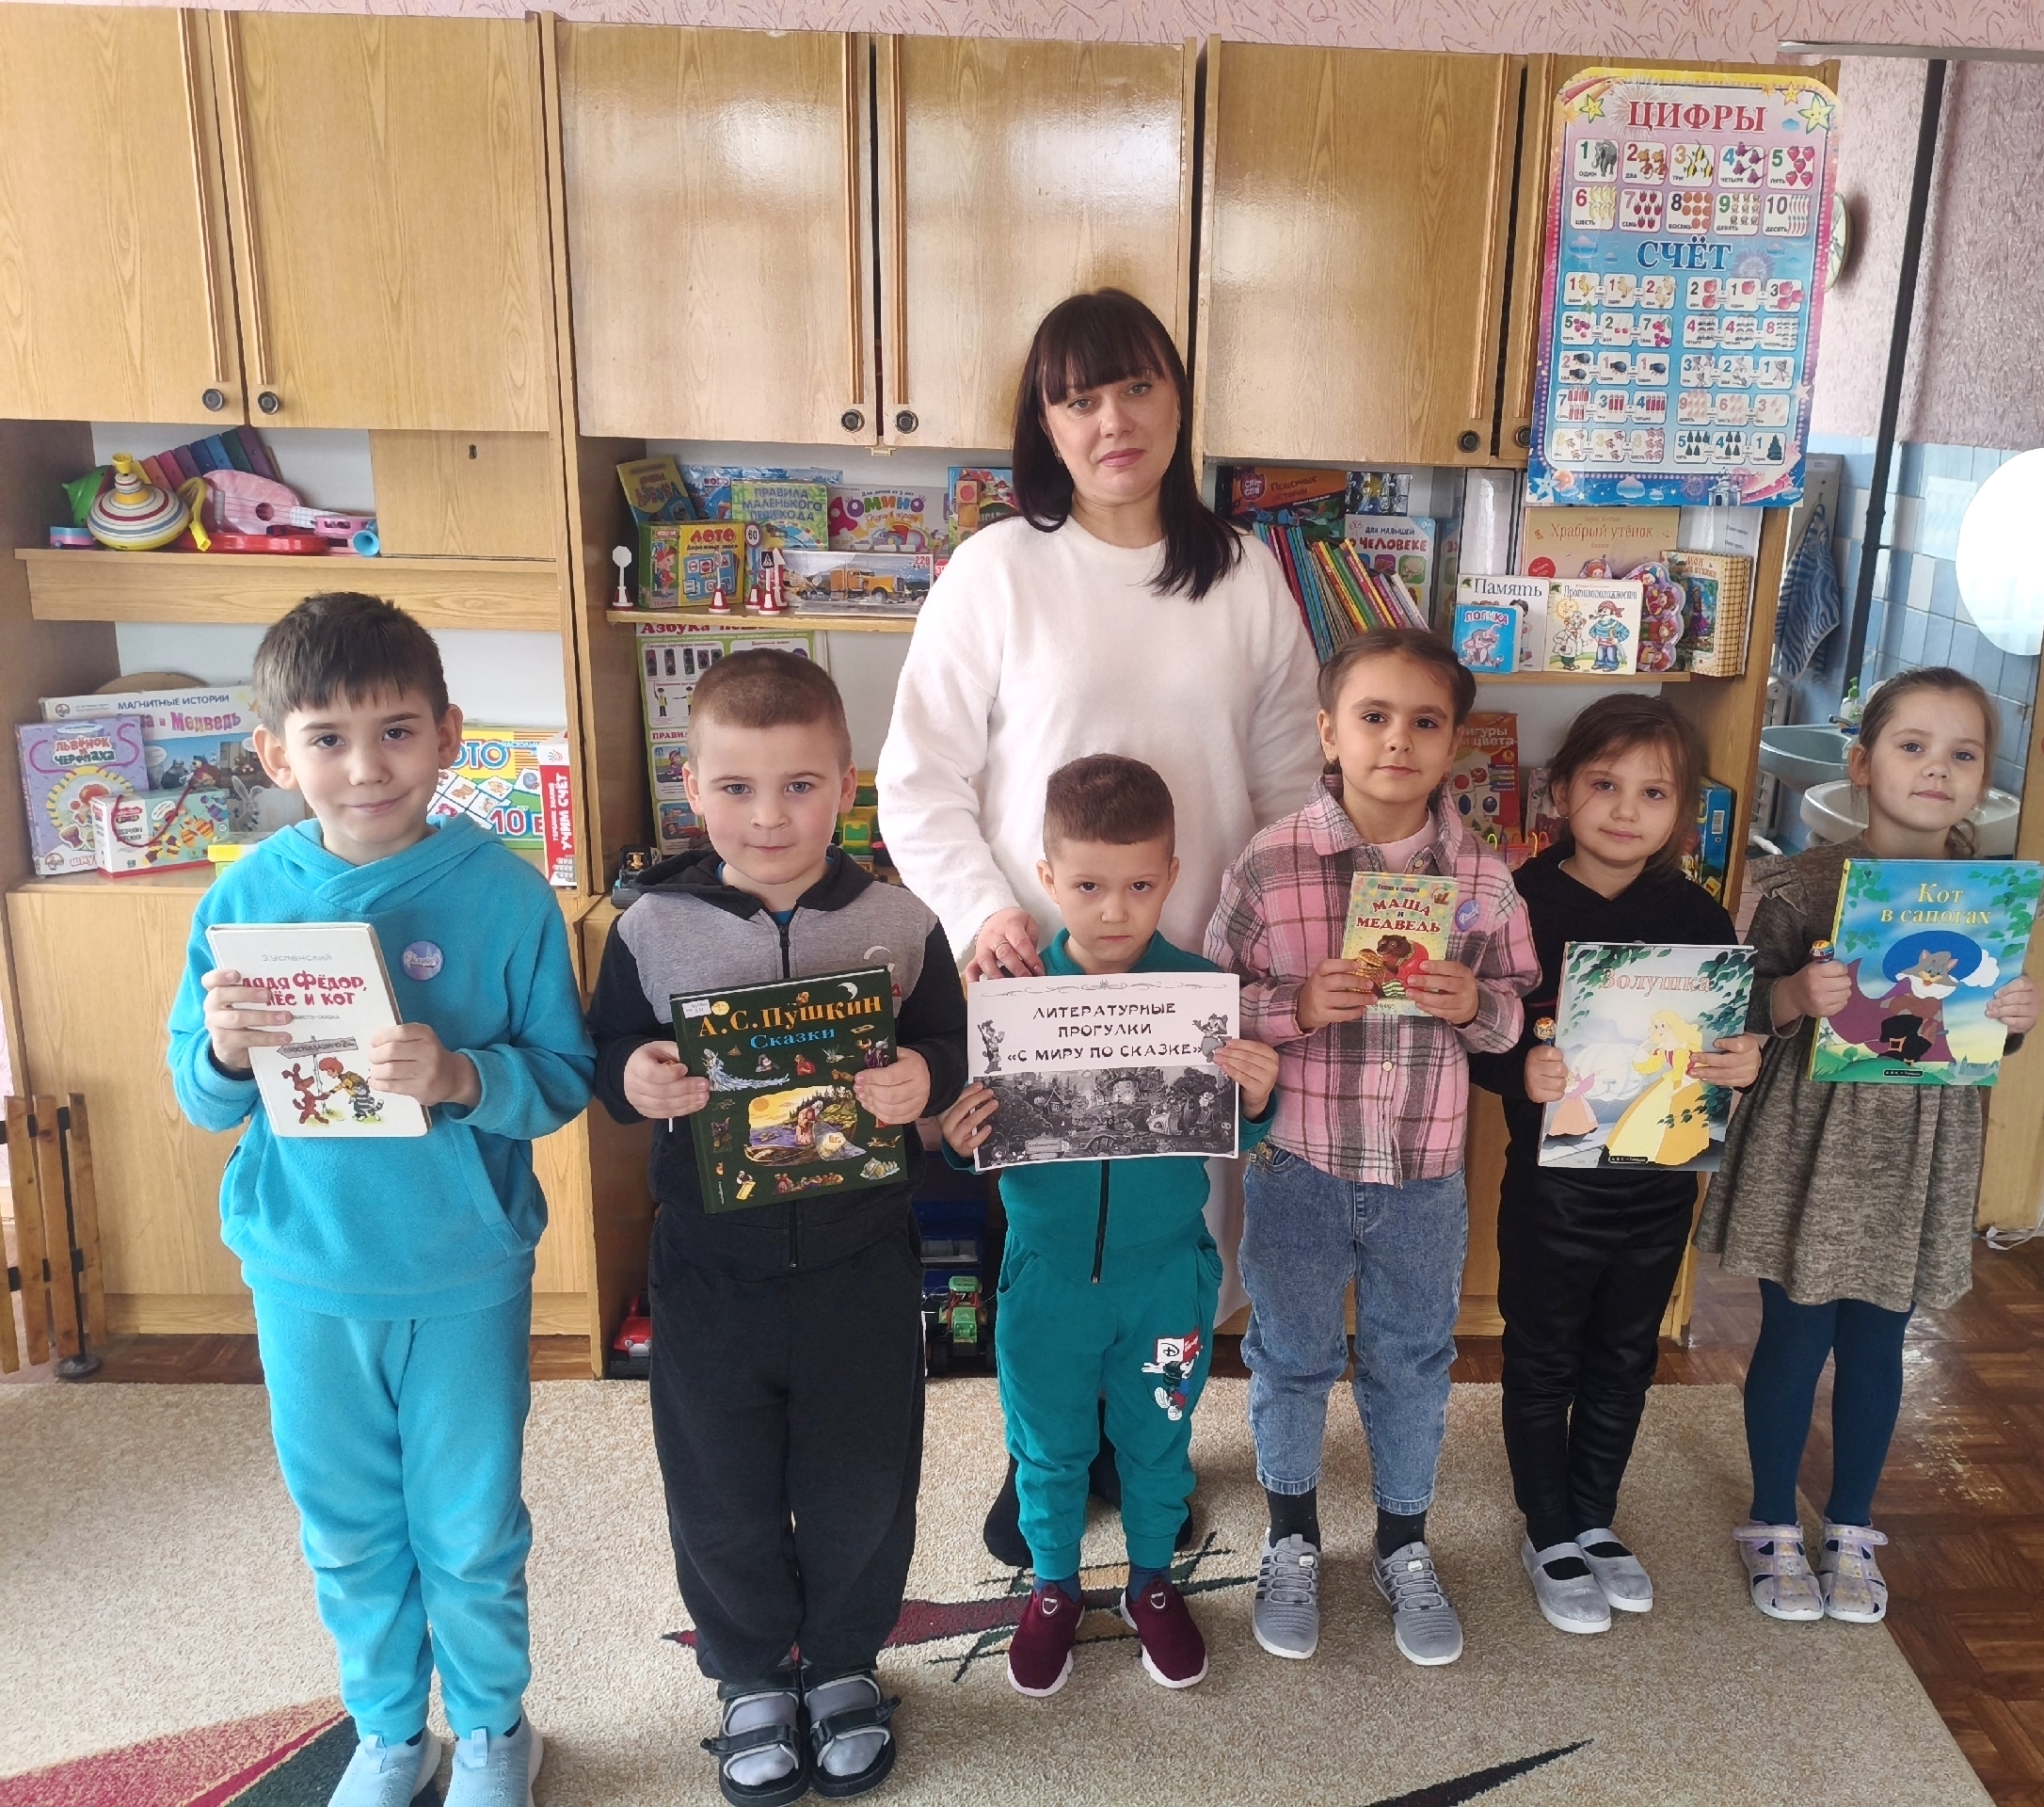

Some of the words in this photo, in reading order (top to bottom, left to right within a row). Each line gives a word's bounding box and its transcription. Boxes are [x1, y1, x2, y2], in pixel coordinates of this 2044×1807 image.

[1627, 101, 1766, 132] ЦИФРЫ
[1580, 141, 1589, 159] 1
[1627, 144, 1638, 161] 2
[1674, 146, 1686, 164] 3
[1722, 148, 1735, 166] 4
[1771, 150, 1783, 168] 5
[1575, 188, 1588, 206] 6
[1624, 191, 1636, 209] 7
[1671, 193, 1683, 211] 8
[1718, 195, 1731, 213] 9
[1767, 197, 1788, 215] 10
[1637, 236, 1733, 270] СЧЁТ
[1570, 277, 1576, 290] 1
[1609, 279, 1615, 291] 1
[1646, 280, 1655, 293] 2
[1690, 281, 1699, 295] 2
[1731, 283, 1737, 296] 1
[1770, 284, 1779, 296] 3
[1564, 315, 1573, 328] 5
[1605, 316, 1614, 329] 2
[1643, 317, 1652, 330] 7
[1687, 319, 1696, 332] 4
[1726, 321, 1735, 333] 4
[1766, 321, 1775, 334] 8
[1561, 355, 1570, 368] 2
[1604, 356, 1609, 369] 1
[1641, 357, 1647, 370] 1
[1684, 358, 1692, 371] 3
[1723, 360, 1732, 373] 2
[1764, 360, 1770, 373] 1
[1558, 394, 1567, 407] 7
[1599, 394, 1607, 408] 3
[1637, 396, 1645, 408] 4
[1679, 397, 1687, 409] 9
[1719, 398, 1728, 410] 6
[1758, 399, 1766, 411] 3
[1557, 432, 1565, 446] 3
[1596, 434, 1605, 447] 3
[1634, 434, 1642, 447] 6
[1678, 436, 1686, 448] 5
[1716, 436, 1724, 448] 4
[1756, 437, 1762, 449] 1
[755, 488, 808, 498] ПРАВИЛА
[743, 499, 822, 511] МАЛЕНЬКОГО
[750, 510, 814, 521] ПЕШЕХОДА
[690, 528, 735, 543] ЛОТО
[748, 529, 758, 540] 60
[1551, 523, 1607, 540] Храбрый
[1611, 525, 1653, 540] утёнок
[1360, 537, 1428, 552] ЧЕЛОВЕКЕ
[1475, 578, 1542, 598] Память
[1465, 610, 1509, 625] ЛОГИКА
[641, 622, 711, 634] Азбука
[118, 697, 181, 710] МАГНИТНЫЕ
[183, 695, 230, 705] ИСТОРИИ
[170, 712, 242, 731] Медведь
[56, 737, 111, 751] ЛЬВЁНОК
[1474, 738, 1514, 746] цвета
[453, 741, 510, 770] ОТО
[554, 773, 570, 808] СЧЁТ
[489, 809, 526, 835] 10
[558, 810, 573, 851] УЧИМ
[1918, 883, 1964, 904] Кот
[1372, 898, 1430, 917] МАША
[1356, 917, 1442, 934] МЕДВЕДЬ
[1880, 909, 1893, 923] в
[1900, 908, 1990, 926] сапогах
[293, 970, 367, 992] ФЁДОР,
[1601, 967, 1711, 997] Золушка
[305, 993, 315, 1005] И
[321, 992, 356, 1006] КОТ
[1032, 1002, 1176, 1020] ЛИТЕРАТУРНЫЕ
[750, 1028, 836, 1049] Сказки
[1058, 1023, 1152, 1038] ПРОГУЛКИ
[1007, 1049, 1028, 1063] «С
[1035, 1047, 1084, 1062] МИРУ
[1090, 1047, 1113, 1059] ПО
[1120, 1043, 1203, 1058] СКАЗКЕ»
